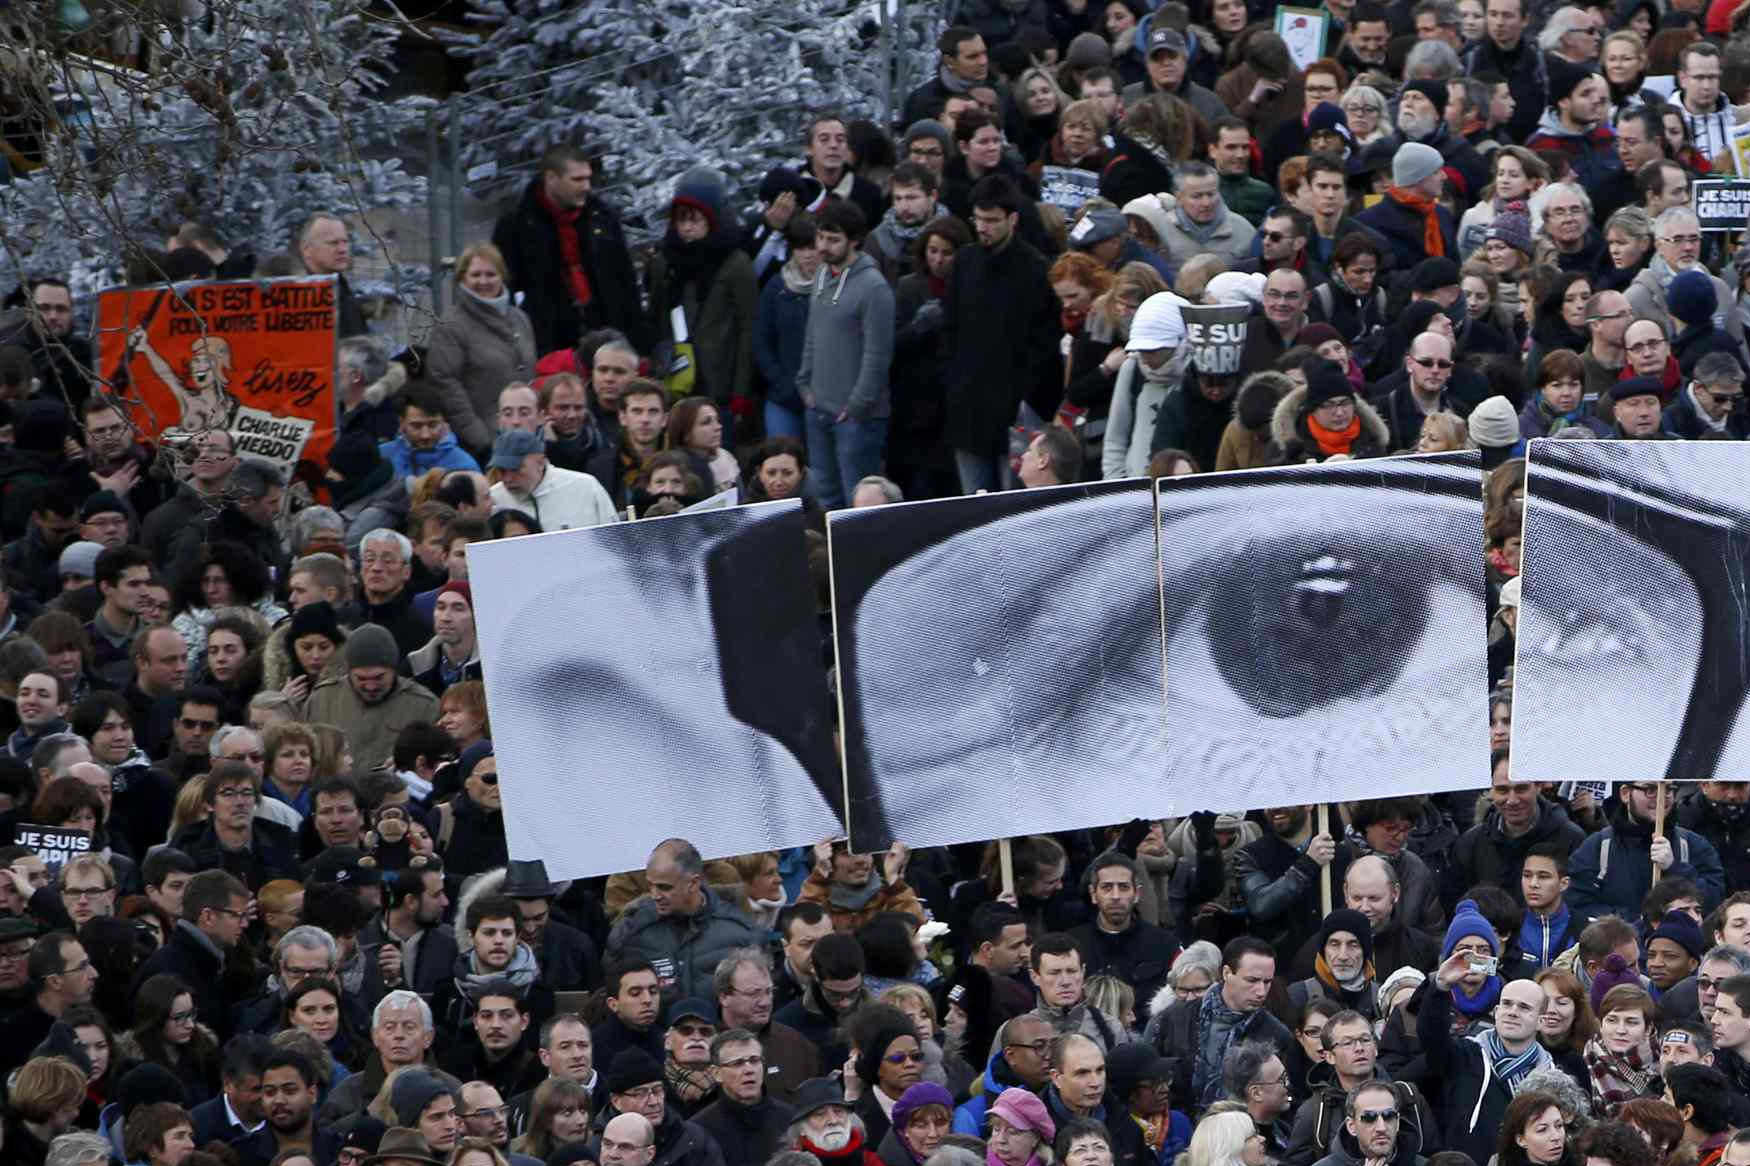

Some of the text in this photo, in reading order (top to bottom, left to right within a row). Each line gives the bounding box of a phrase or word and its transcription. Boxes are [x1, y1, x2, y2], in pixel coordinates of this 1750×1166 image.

[1698, 190, 1719, 202] JE
[260, 284, 334, 308] BATTUS
[212, 314, 257, 332] VOTRE
[238, 416, 304, 442] CHARLIE
[237, 436, 296, 461] HEBDO
[15, 832, 91, 851] JE SUIS
